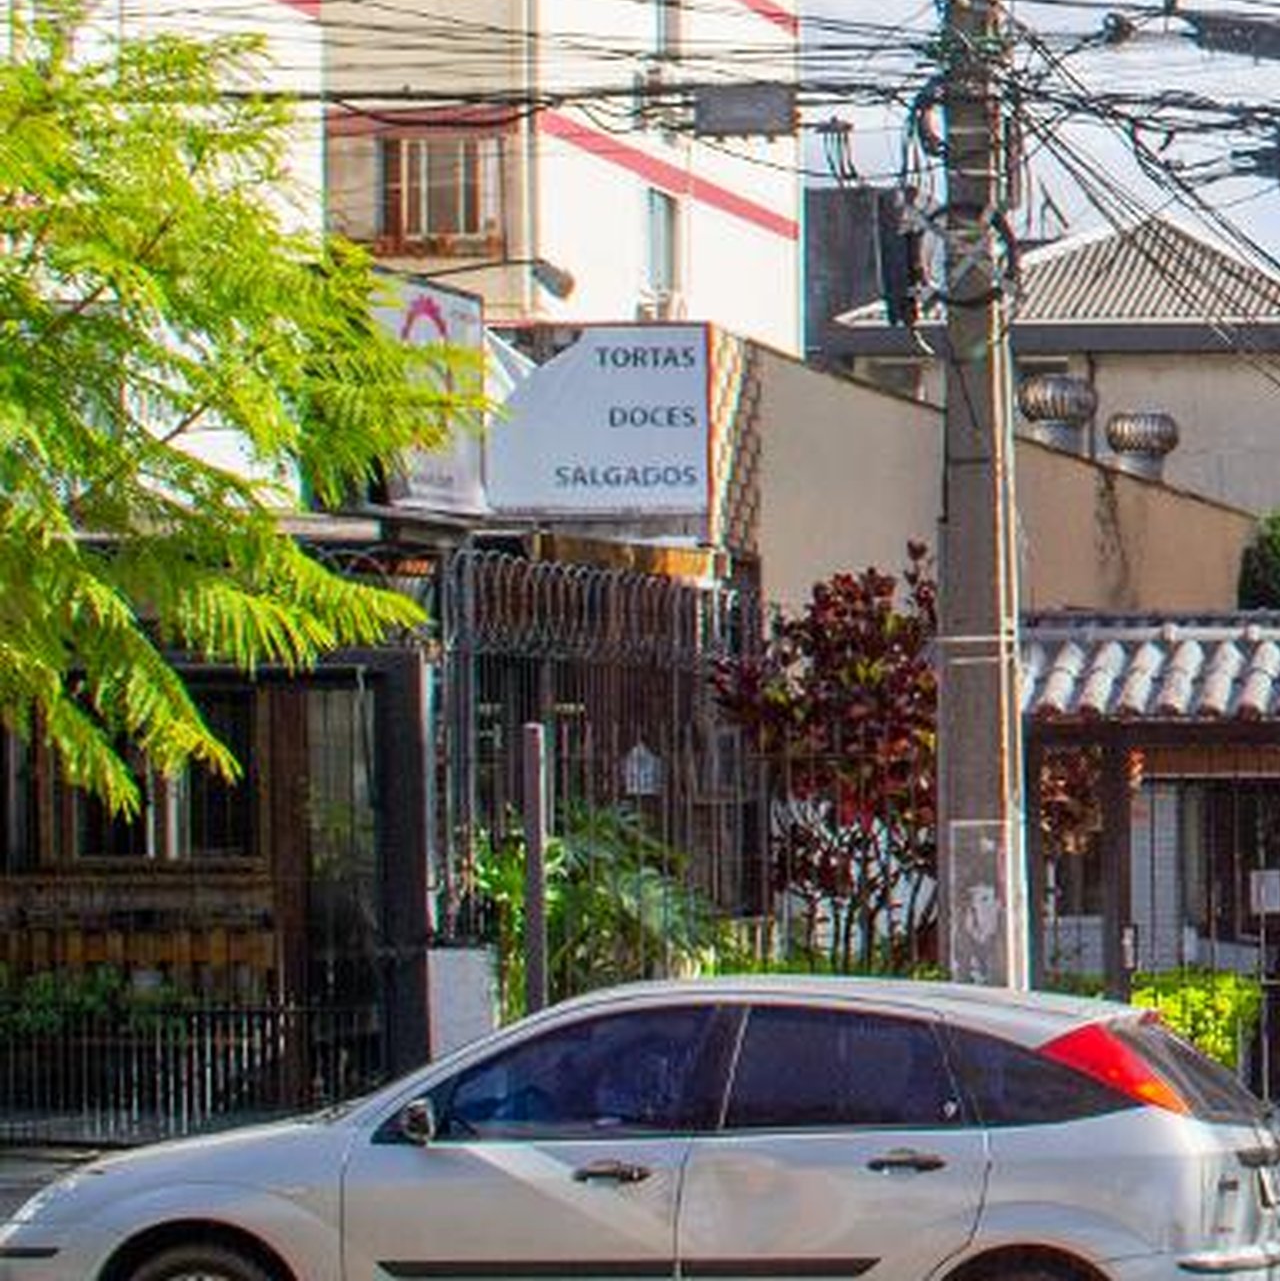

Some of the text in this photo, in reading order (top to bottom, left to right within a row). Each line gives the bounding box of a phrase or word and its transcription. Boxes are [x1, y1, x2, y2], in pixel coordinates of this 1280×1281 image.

[595, 346, 696, 368] TORTAS
[608, 405, 697, 428] DOCES
[555, 465, 698, 487] SALGADOS
